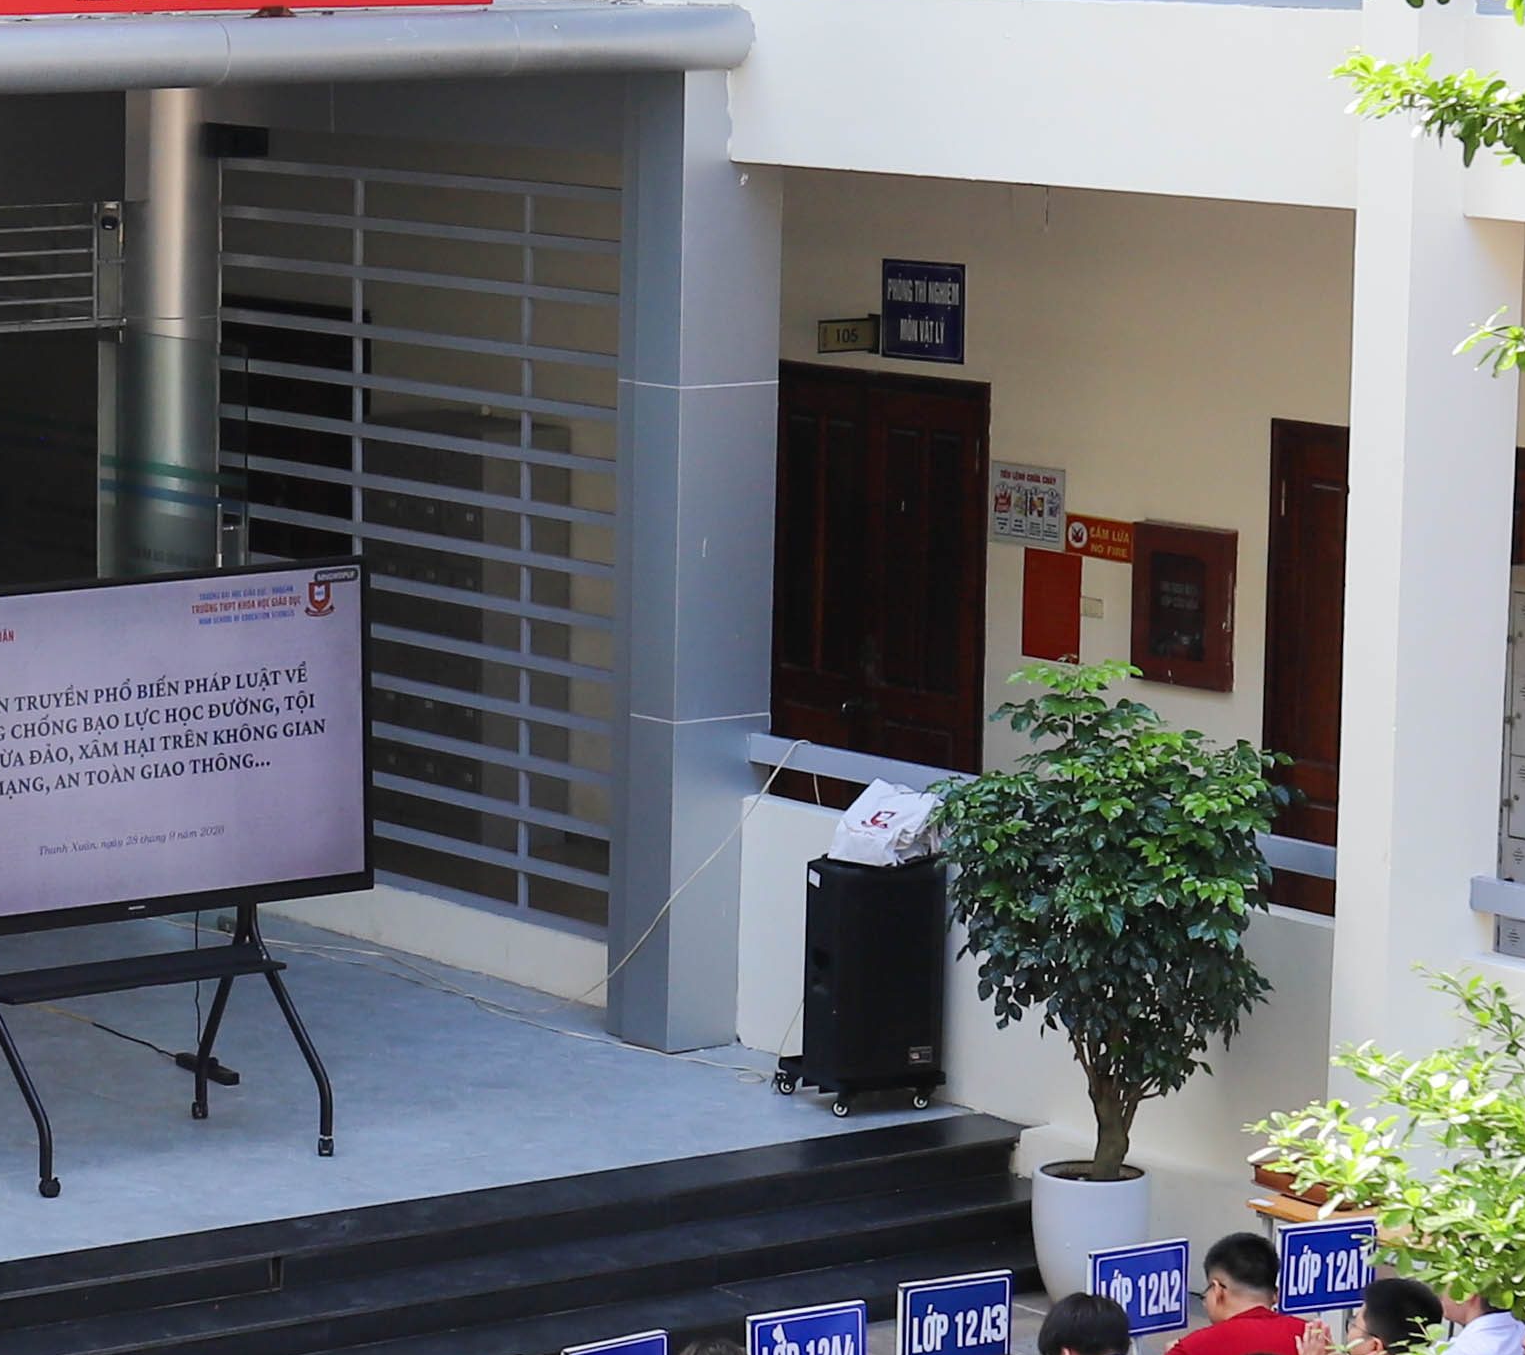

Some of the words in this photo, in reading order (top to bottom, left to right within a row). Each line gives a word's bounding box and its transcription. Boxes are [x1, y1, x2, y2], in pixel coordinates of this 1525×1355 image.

[836, 328, 859, 344] 105
[1107, 546, 1128, 559] FIRE
[14, 684, 90, 712] TRUYỀN
[94, 678, 132, 705] PHỔ
[136, 674, 180, 700] BIẾN
[184, 671, 232, 695] PHÁP
[236, 667, 282, 691] LUẬT
[285, 661, 309, 684] VỀ
[10, 714, 78, 739] CHỐNG
[83, 713, 120, 736] BẠO
[124, 707, 161, 731] LỰC
[164, 705, 205, 727] HỌC
[208, 696, 281, 719] ĐƯỜNG,
[284, 690, 316, 714] TỘI
[29, 743, 75, 765] ĐẢO,
[78, 739, 119, 760] XÂM
[123, 736, 155, 758] HẠI
[159, 729, 209, 752] TRÊN
[212, 723, 278, 746] KHÔNG
[282, 719, 327, 739] GIAN
[54, 771, 80, 790] AN
[84, 764, 136, 786] TOÀN
[140, 760, 185, 780] GIAO
[188, 752, 271, 775] THÔNG...
[1287, 1240, 1323, 1297] LỚP
[1139, 1269, 1183, 1318] 12A2
[911, 1303, 950, 1355] LỚP
